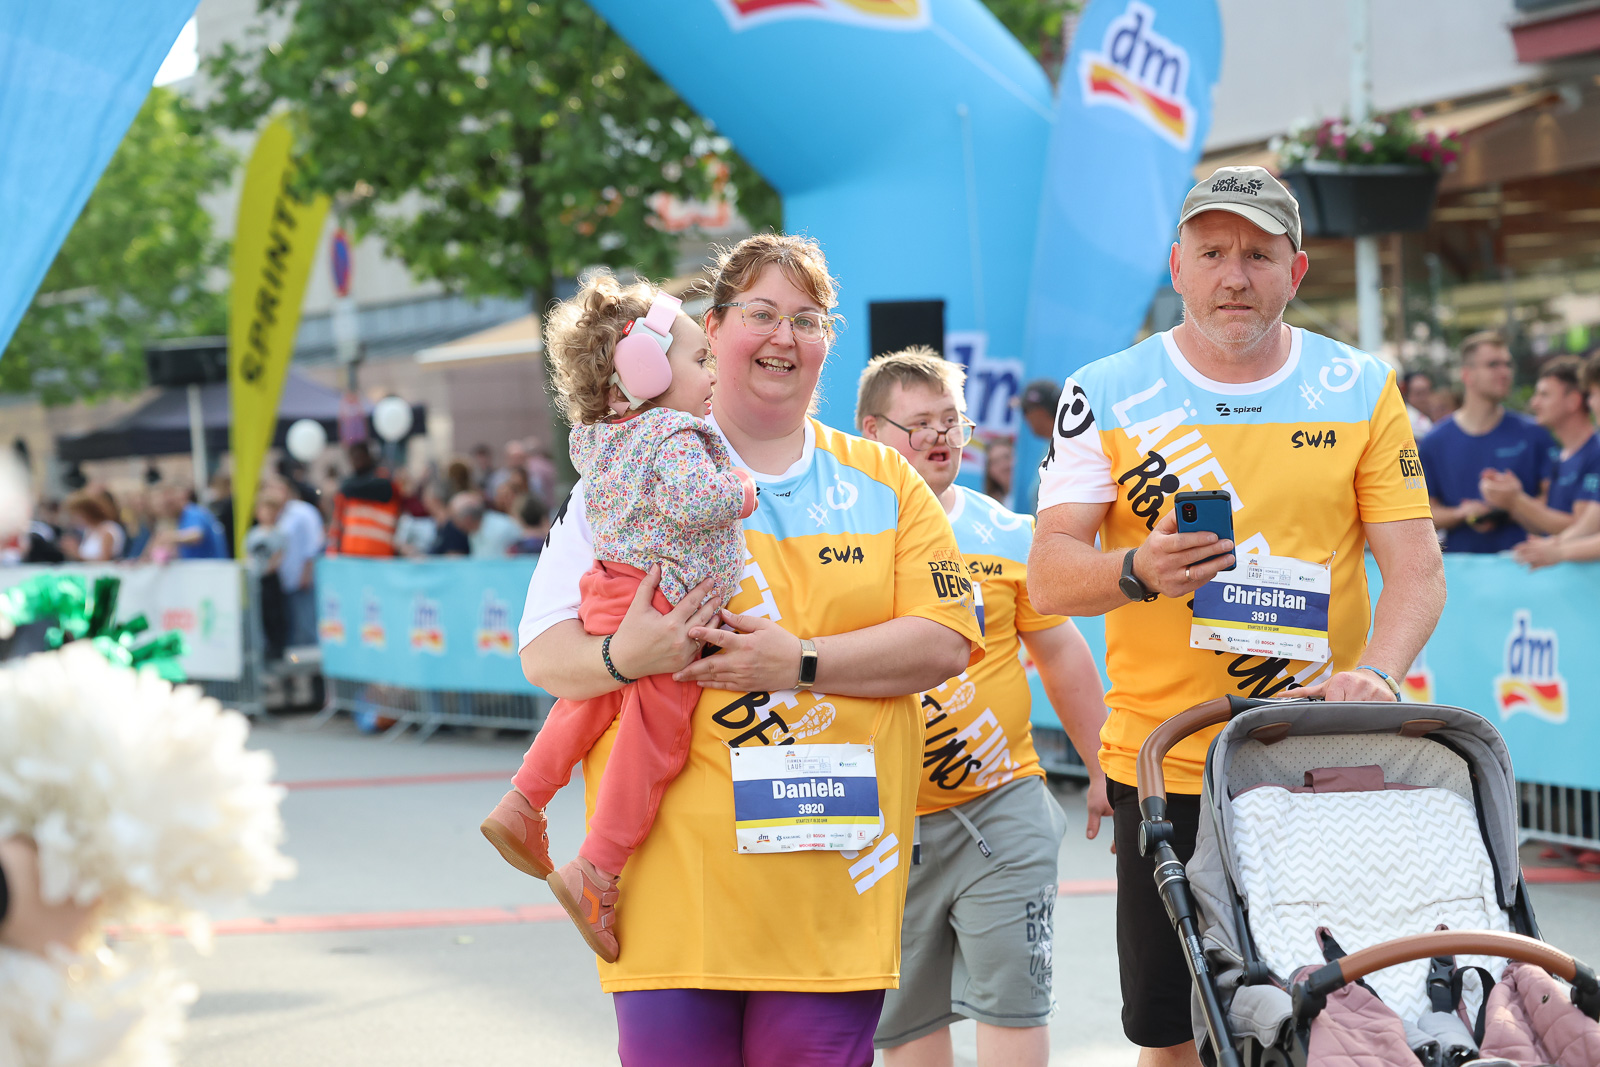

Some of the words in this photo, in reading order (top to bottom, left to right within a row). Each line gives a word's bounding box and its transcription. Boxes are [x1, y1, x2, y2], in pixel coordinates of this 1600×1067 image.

[1110, 11, 1182, 96] dm
[1211, 184, 1258, 196] Wolfskin
[1233, 403, 1262, 414] spized
[1291, 430, 1337, 449] SWA
[818, 545, 864, 565] SWA
[969, 561, 1003, 576] SWA
[1223, 584, 1306, 610] Chrisitan
[1251, 611, 1278, 623] 3919
[1509, 617, 1553, 679] dm
[772, 778, 845, 799] Daniela
[798, 803, 824, 814] 3920
